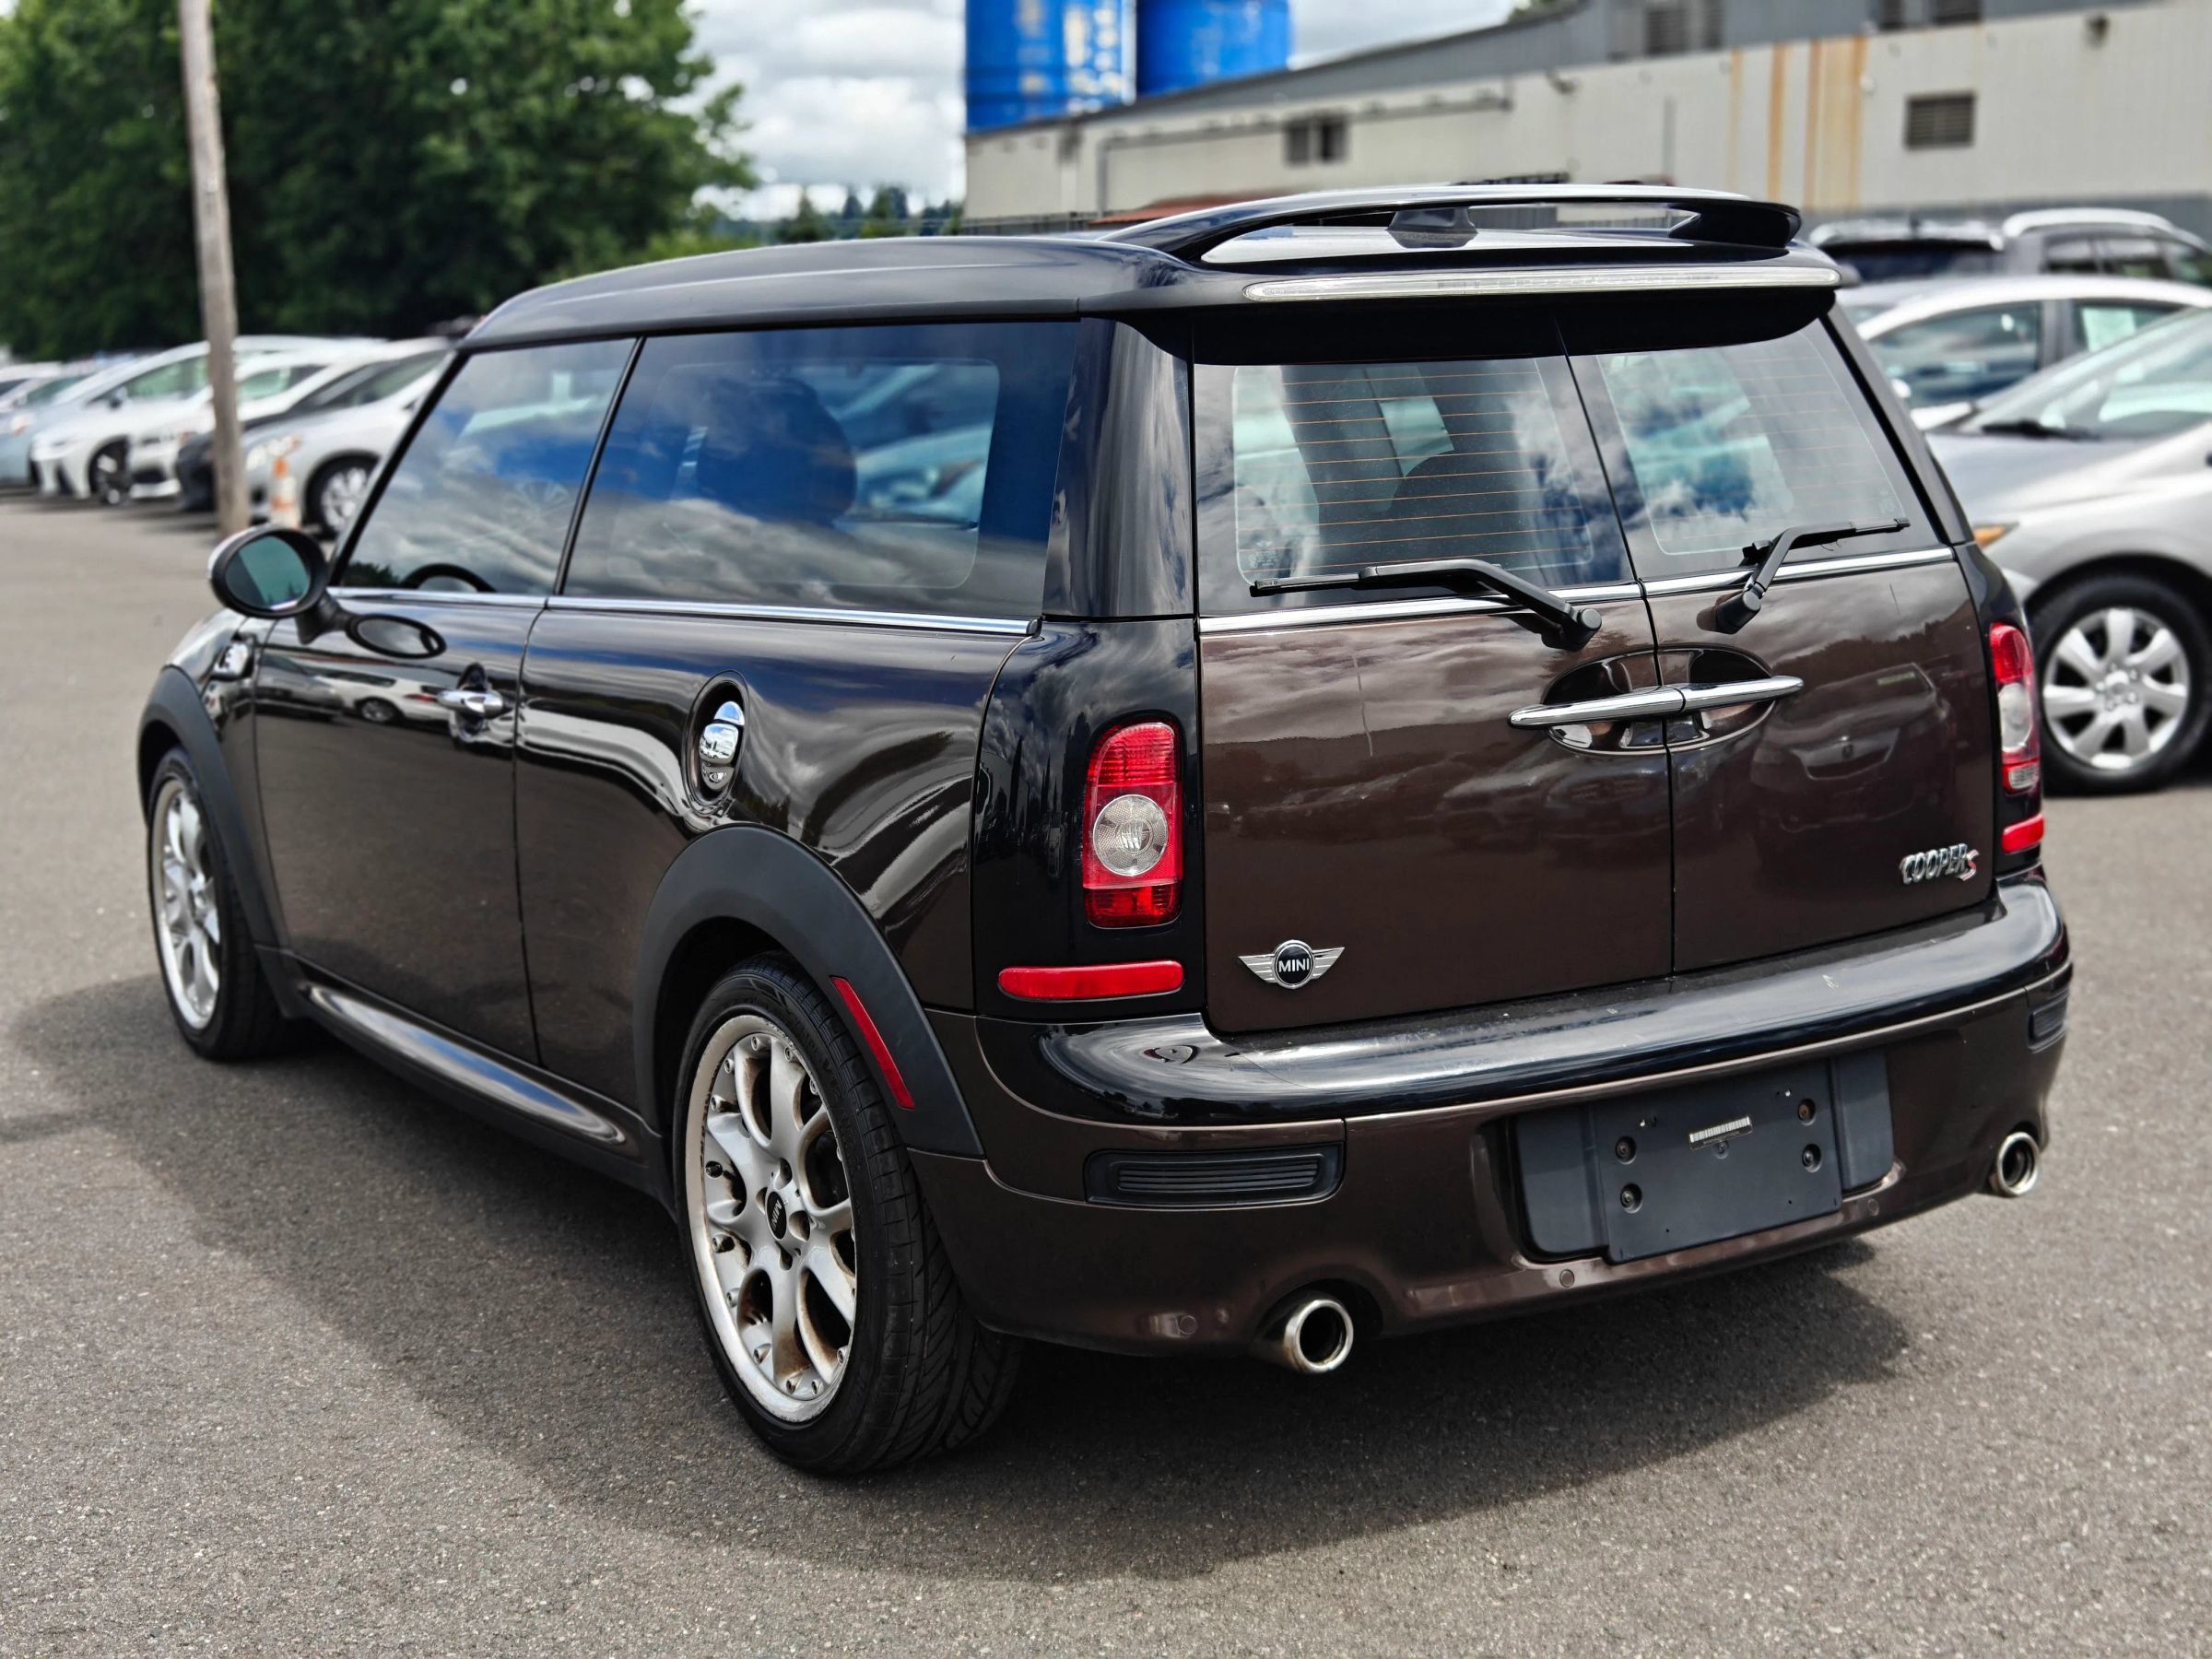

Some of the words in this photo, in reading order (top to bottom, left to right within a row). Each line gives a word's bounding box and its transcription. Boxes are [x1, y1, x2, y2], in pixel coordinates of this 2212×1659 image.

[1900, 842, 1968, 885] COOPER
[1957, 849, 1980, 882] S
[1277, 958, 1310, 973] MINI
